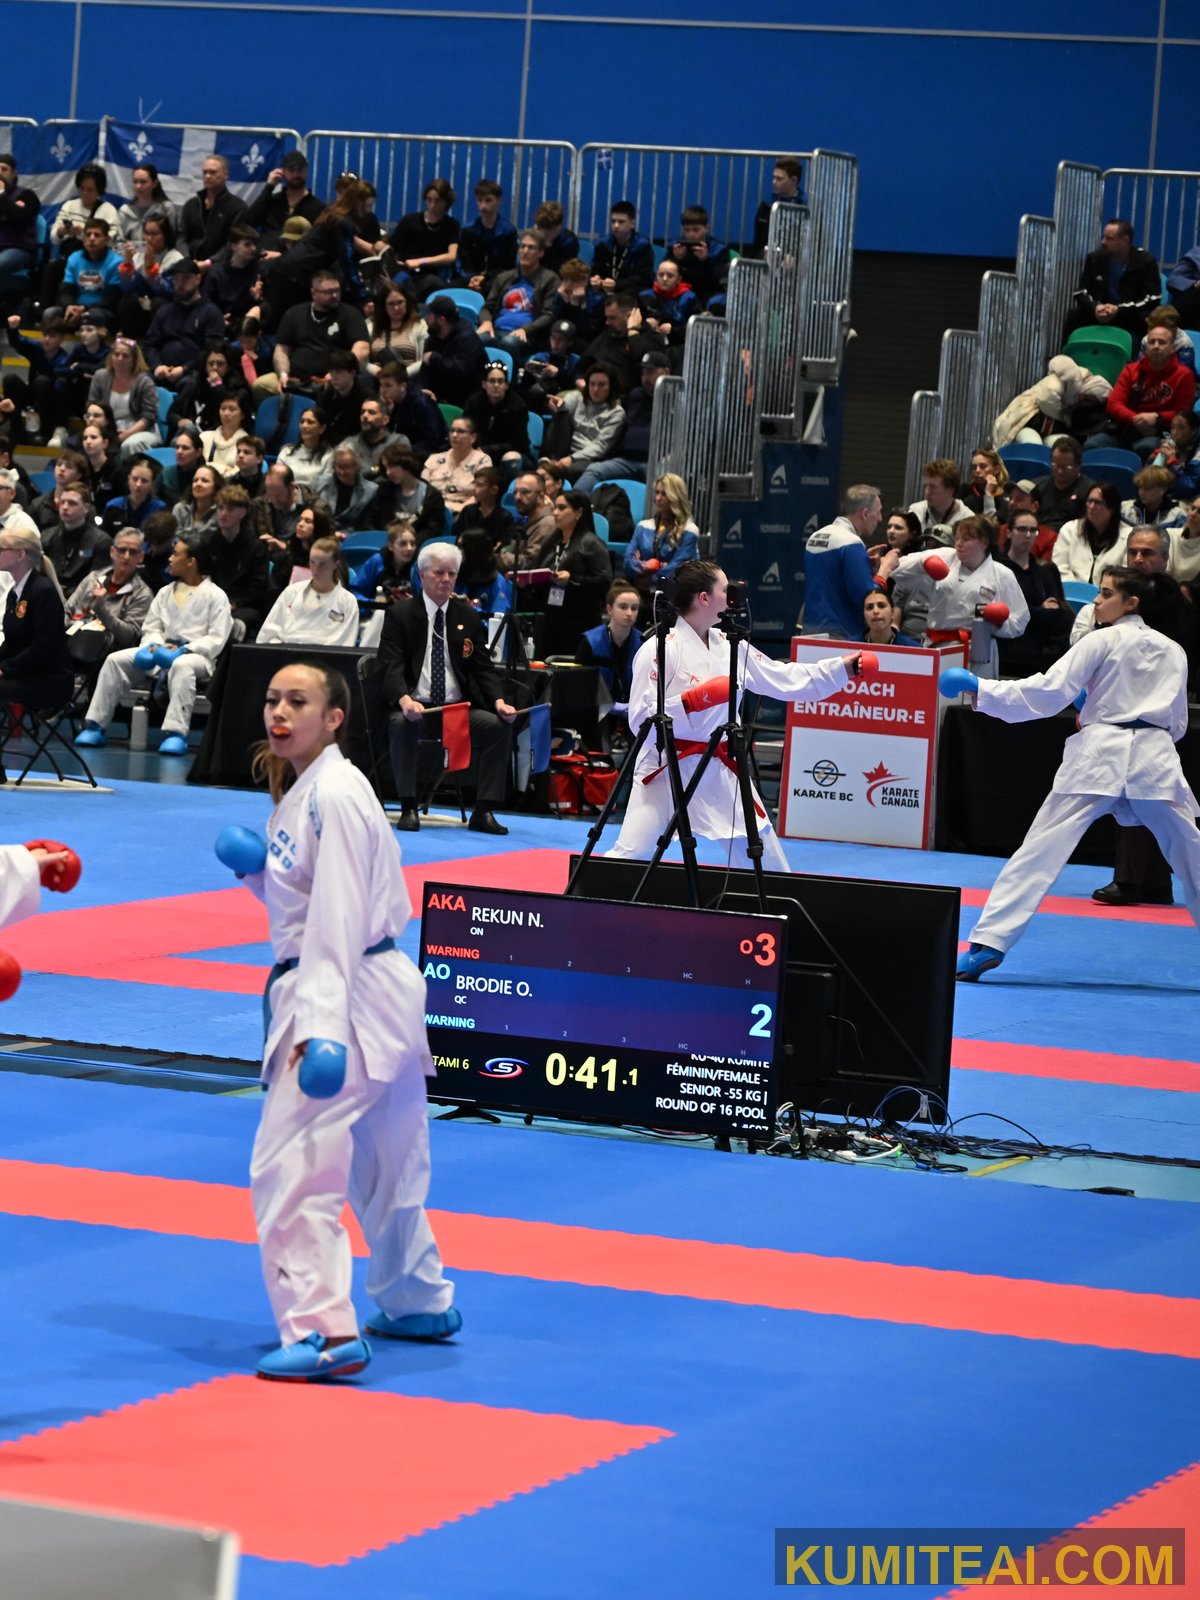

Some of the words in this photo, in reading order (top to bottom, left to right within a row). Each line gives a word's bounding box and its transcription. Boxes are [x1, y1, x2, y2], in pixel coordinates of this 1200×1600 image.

[841, 680, 895, 697] OACH
[793, 701, 925, 724] ENTRAÎNEUR·E
[793, 788, 836, 800] KARATE
[838, 792, 854, 802] BC
[882, 786, 919, 799] KARATE
[881, 796, 919, 809] CANADA
[427, 893, 467, 912] AKA
[471, 906, 523, 926] REKUN
[527, 912, 544, 929] N.
[470, 926, 484, 936] ON
[426, 944, 480, 960] WARNING
[754, 932, 776, 967] 3
[423, 962, 450, 980] AO
[455, 974, 512, 995] BRODIE
[516, 981, 533, 997] O.
[454, 995, 467, 1005] QC
[424, 1013, 476, 1029] WARNING
[749, 1003, 773, 1038] 2
[678, 1042, 689, 1050] HC
[432, 1055, 460, 1069] TAMI
[462, 1058, 470, 1070] 6
[666, 1061, 761, 1085] FÉMININ/FEMALE
[679, 1082, 722, 1098] SENIOR
[724, 1088, 742, 1100] -55
[745, 1090, 761, 1102] KG
[655, 1096, 698, 1112] ROUND
[700, 1101, 717, 1114] OF
[719, 1104, 733, 1116] 16
[735, 1105, 767, 1120] POOL
